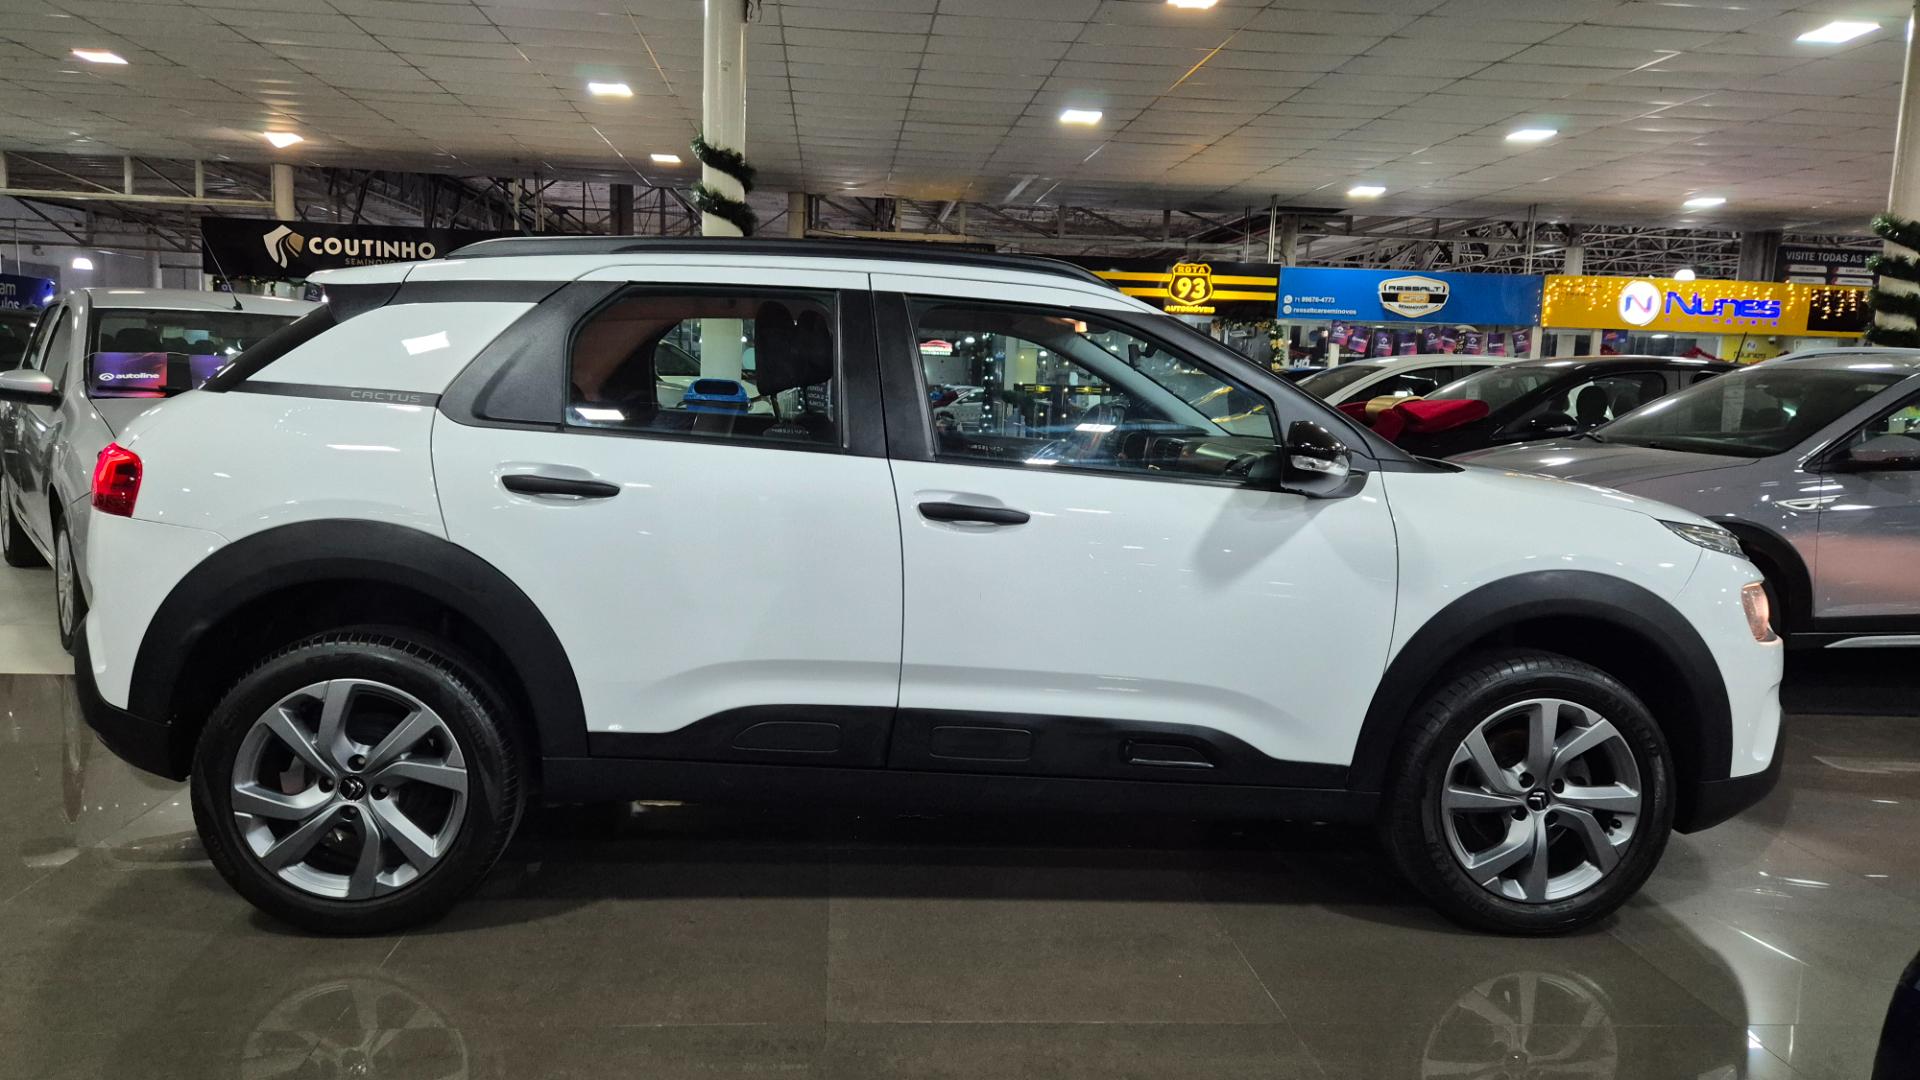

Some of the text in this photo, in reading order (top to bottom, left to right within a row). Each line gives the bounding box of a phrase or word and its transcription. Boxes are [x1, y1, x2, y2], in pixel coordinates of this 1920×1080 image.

[308, 236, 436, 260] COUTINHO
[1786, 252, 1818, 261] VISITE
[1818, 252, 1848, 263] TODAS
[1850, 254, 1862, 263] AS
[1177, 266, 1206, 274] ROTA
[1177, 277, 1206, 299] 93
[1388, 285, 1442, 293] RESSALT
[1164, 304, 1216, 314] AUTOMÓVEIS
[350, 390, 421, 402] CACTUS
